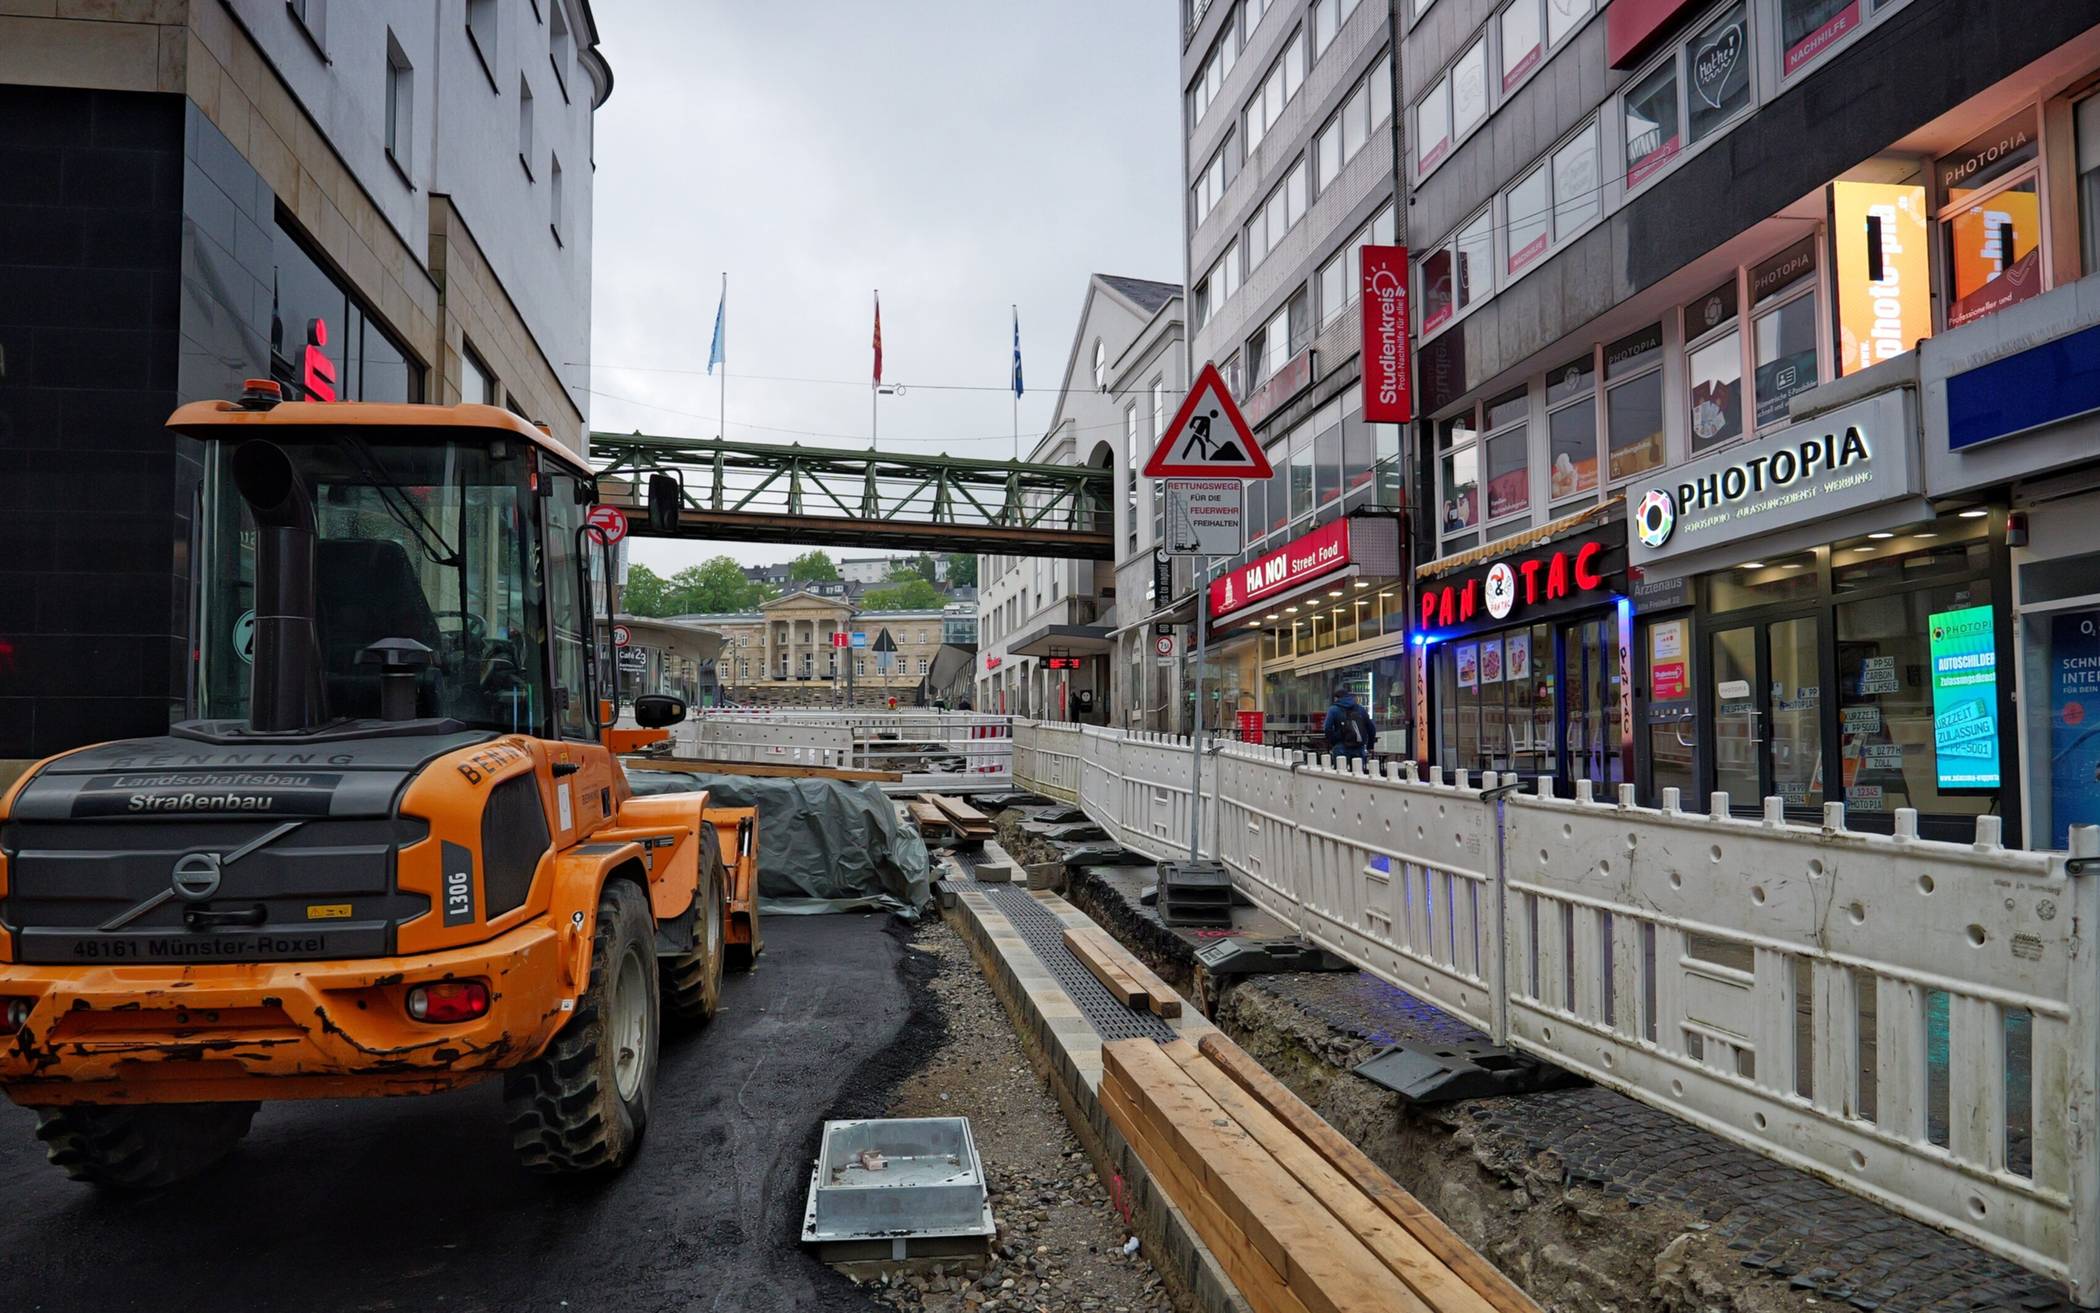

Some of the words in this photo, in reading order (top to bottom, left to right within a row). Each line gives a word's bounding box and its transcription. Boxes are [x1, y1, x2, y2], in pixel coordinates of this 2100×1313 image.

[1790, 18, 1847, 66] NACHHILFE
[1944, 131, 2027, 186] PHOTOPIA
[1754, 252, 1809, 291] PHOTOPIA
[1998, 291, 2013, 308] und
[1378, 287, 1397, 405] Studienkreis
[1608, 338, 1657, 366] PHOTOPIA
[1397, 331, 1406, 391] Profi-Nachhilfe
[1678, 426, 1869, 515] PHOTOPIA
[1167, 482, 1240, 490] RETTUNGSWEGE
[1190, 493, 1206, 501] FÜR
[1208, 494, 1222, 502] DIE
[1684, 512, 1731, 533] FOTOSTUDIO
[1736, 486, 1818, 518] ZULASSUNGSDIENST
[1823, 470, 1873, 494] WERBUNG
[1246, 565, 1264, 593] HA
[1265, 553, 1287, 585] NOI
[1291, 552, 1316, 573] Street
[1318, 540, 1338, 562] Food
[1421, 579, 1478, 631] PAN
[1520, 541, 1602, 605] TAC
[619, 651, 634, 659] Café
[635, 648, 647, 664] 23
[1620, 646, 1629, 686] PAN
[1865, 670, 1893, 681] CARBON
[1808, 688, 1818, 697] PP
[2063, 686, 2077, 695] FÜR
[2079, 685, 2098, 694] DEIN
[1622, 692, 1631, 734] TAC
[1937, 721, 1990, 743] ZULASSUNG
[109, 753, 355, 769] BENNING
[1874, 758, 1893, 768] ZOLL
[113, 773, 312, 789] Landschaftsbau
[127, 793, 273, 812] Straßenbau
[1847, 800, 1882, 809] PHOTOPIA
[448, 872, 469, 915] L30G
[74, 940, 137, 957] 48161
[149, 935, 326, 957] Münster-Roxel
